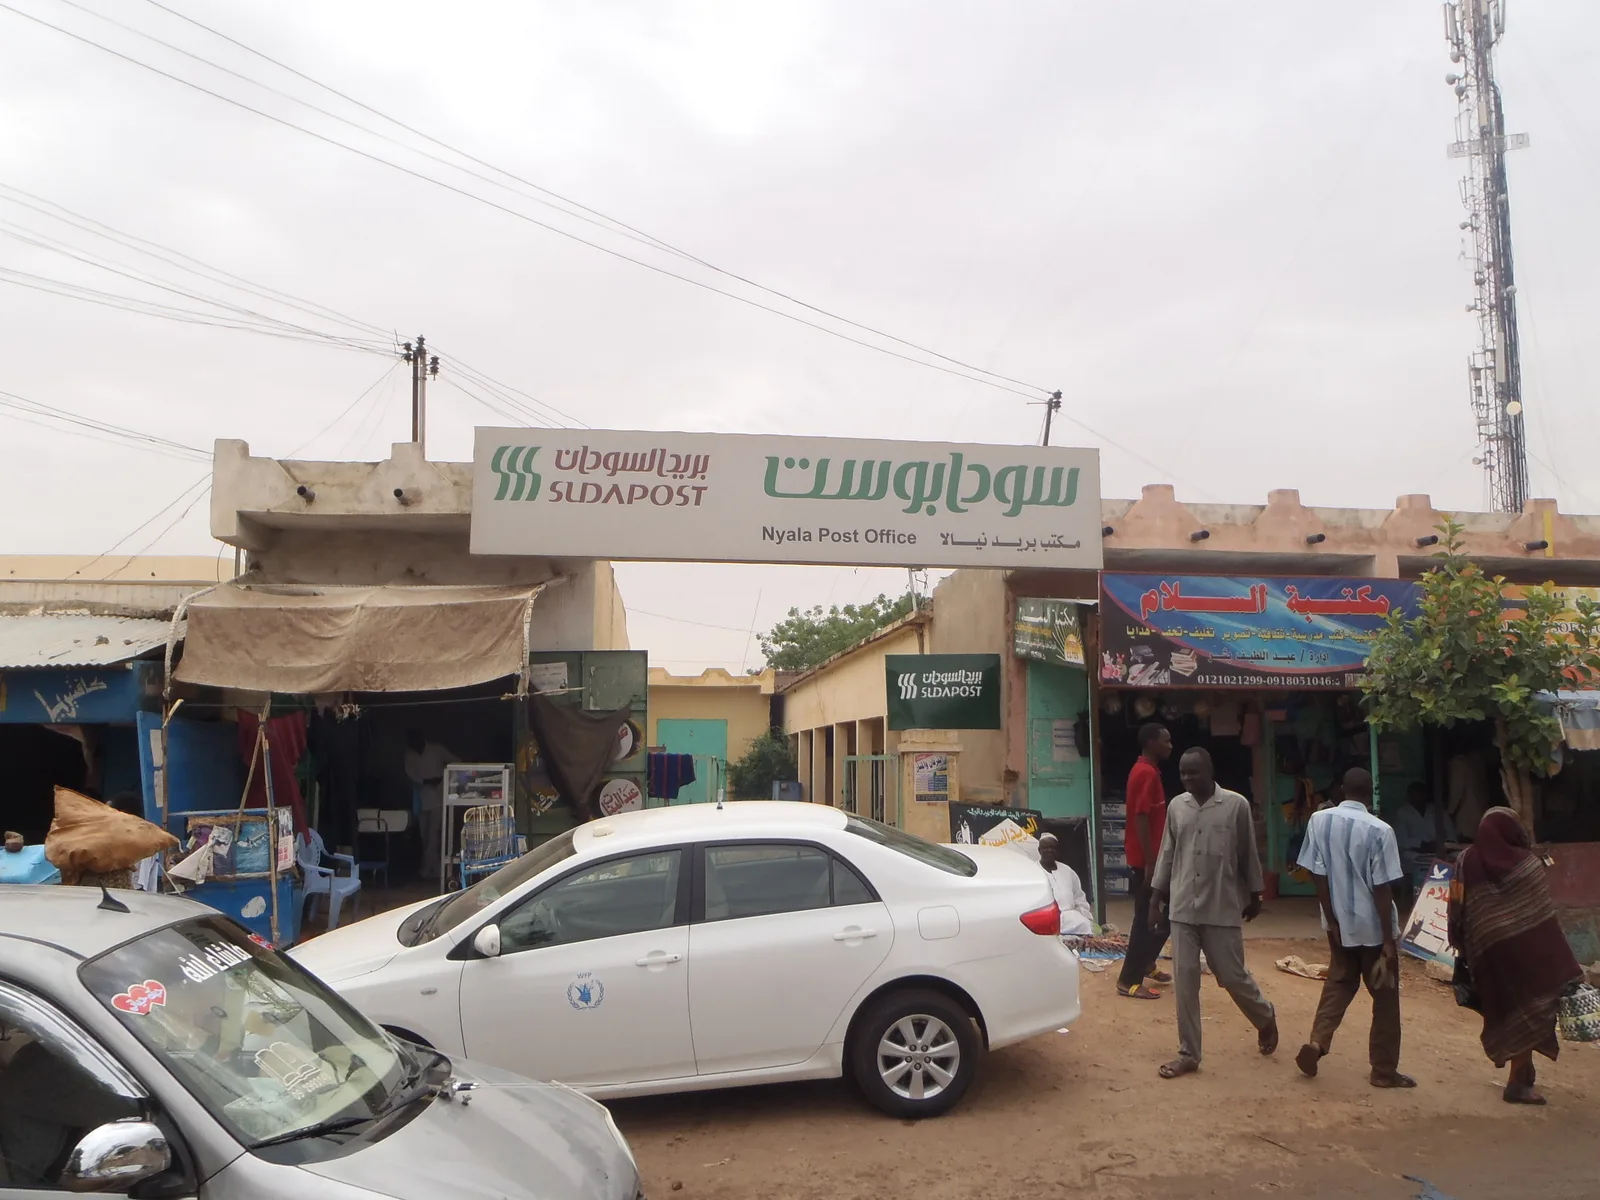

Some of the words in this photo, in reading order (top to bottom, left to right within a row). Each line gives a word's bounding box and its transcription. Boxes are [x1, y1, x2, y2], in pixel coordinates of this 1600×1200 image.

[548, 480, 709, 507] SUDAPOST
[762, 526, 812, 546] Nyala
[818, 527, 859, 544] Post
[864, 528, 918, 545] Office
[939, 532, 988, 551] نيالا
[991, 535, 1037, 553] بريد
[1040, 534, 1081, 552] مكتب
[1139, 581, 1268, 620] السلام
[1285, 584, 1391, 623] مكتبة
[1272, 651, 1296, 664] عبد
[921, 685, 983, 698] SUDAPOST
[178, 953, 219, 983] الله
[576, 971, 592, 980] WFP
